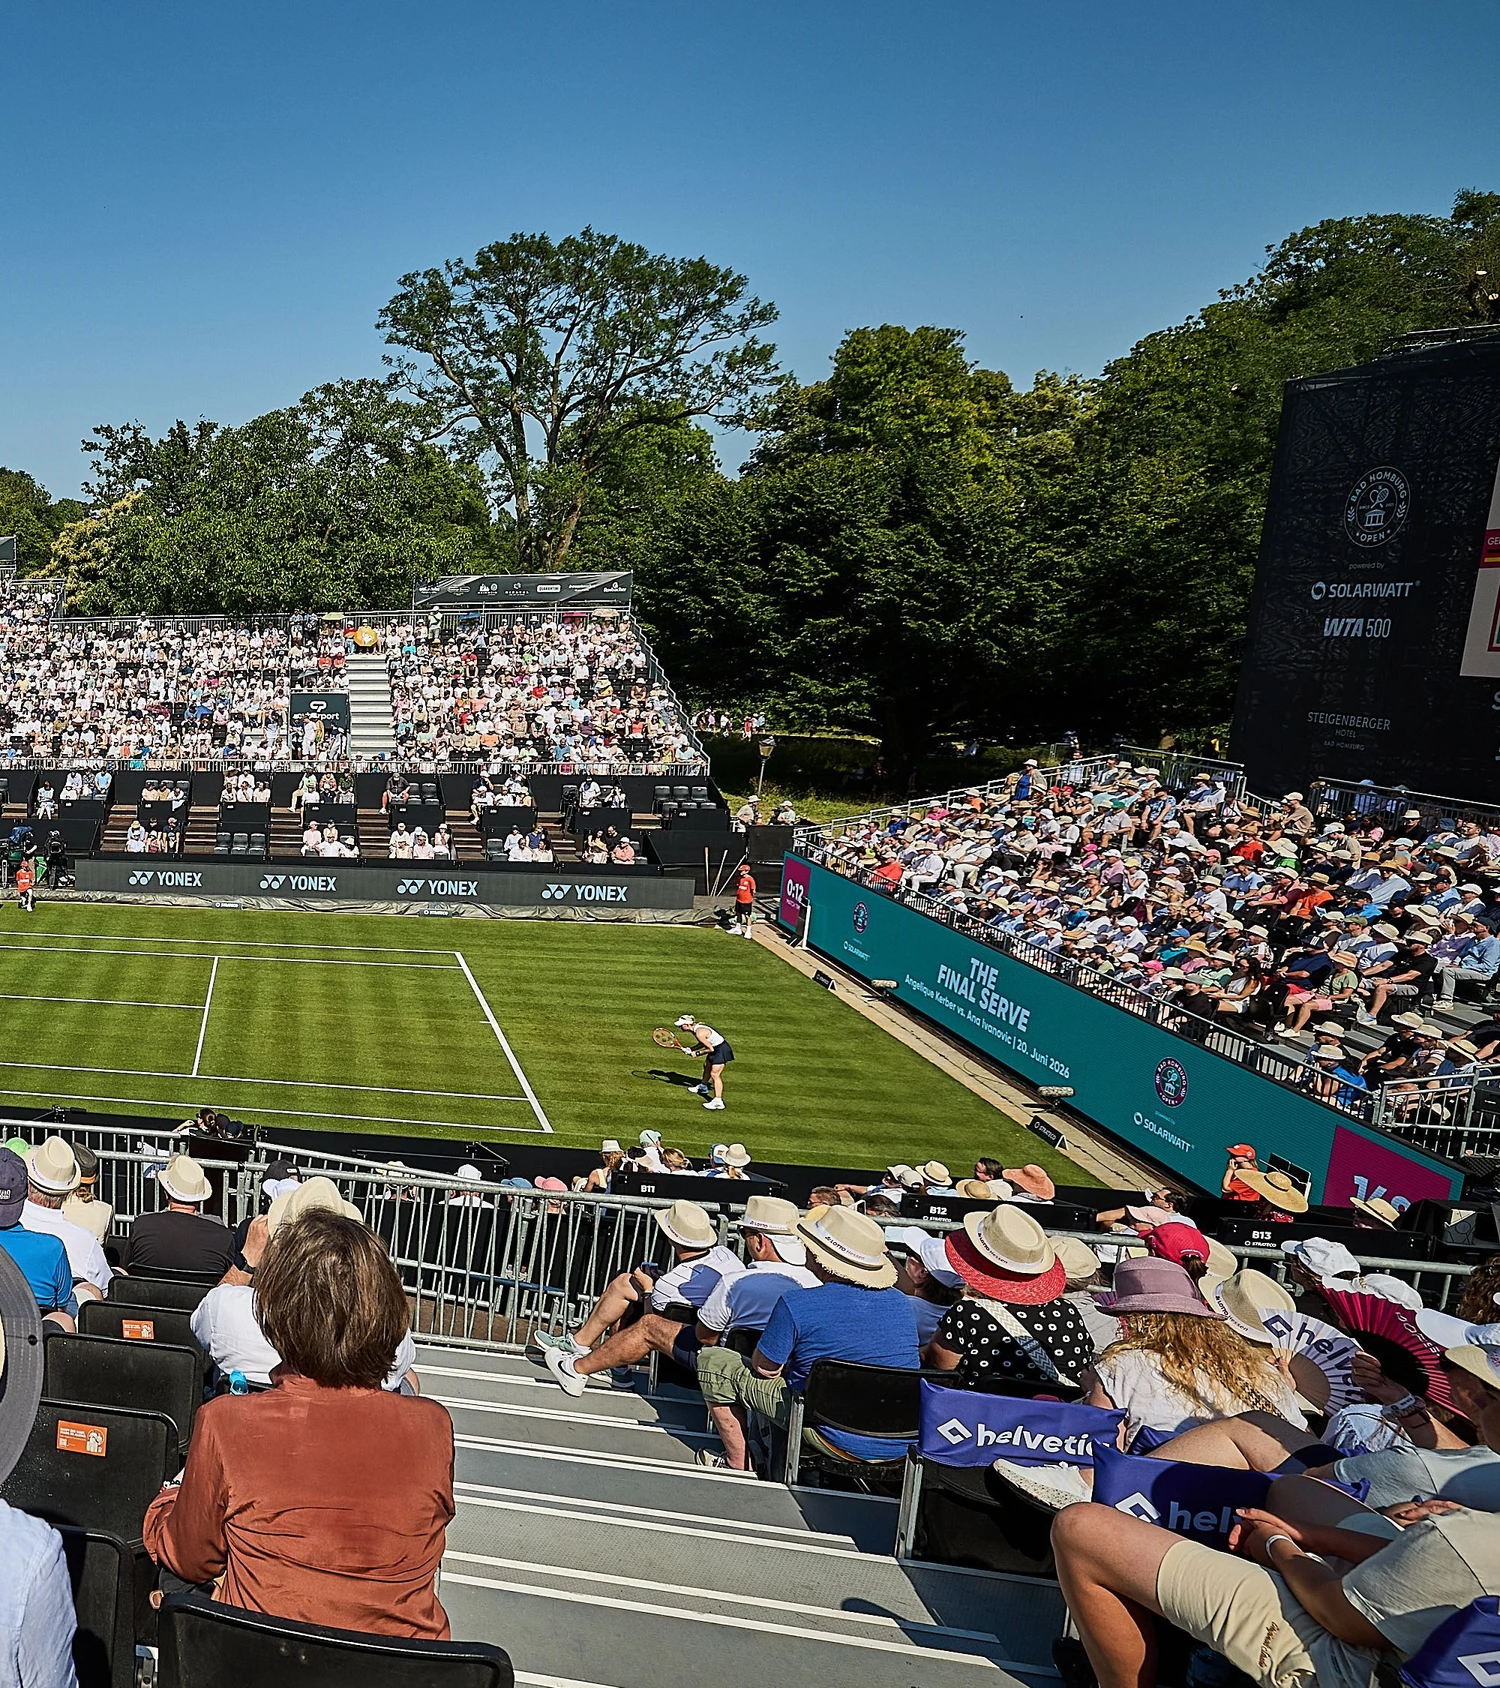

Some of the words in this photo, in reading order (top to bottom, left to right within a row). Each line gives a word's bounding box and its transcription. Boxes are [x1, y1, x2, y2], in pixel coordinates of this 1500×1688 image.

[1350, 481, 1367, 502] BAD
[1369, 471, 1407, 499] HOMBURG
[1360, 531, 1385, 543] OPEN
[1328, 582, 1413, 598] SOLARWATT
[1323, 616, 1364, 637] WTA
[1365, 618, 1392, 638] 500
[1308, 712, 1391, 730] STEIGENBERGER
[1335, 730, 1356, 738] HOTEL
[157, 871, 202, 887] YONEX
[289, 875, 337, 892] YONEX
[428, 879, 478, 897] YONEX
[576, 884, 628, 902] YONEX
[787, 879, 804, 902] 0:12
[970, 957, 999, 991] THE
[937, 964, 976, 1003] FINAL
[979, 987, 1031, 1032] SERVE
[905, 974, 935, 999] Angelique
[934, 992, 957, 1011] Kerber
[966, 1010, 981, 1026] Ana
[981, 1018, 1012, 1045] Ivanovic
[1017, 1039, 1029, 1055] 20.
[1030, 1048, 1049, 1066] Juni
[1049, 1058, 1071, 1079] 2026
[1143, 1118, 1191, 1153] SOLARWATT
[641, 1185, 655, 1193] B11
[930, 1206, 947, 1215] B12
[1252, 1230, 1272, 1240] B13
[830, 1240, 847, 1252] LOTTO
[1217, 1300, 1229, 1316] LOTTO
[1228, 1314, 1249, 1332] Hessen
